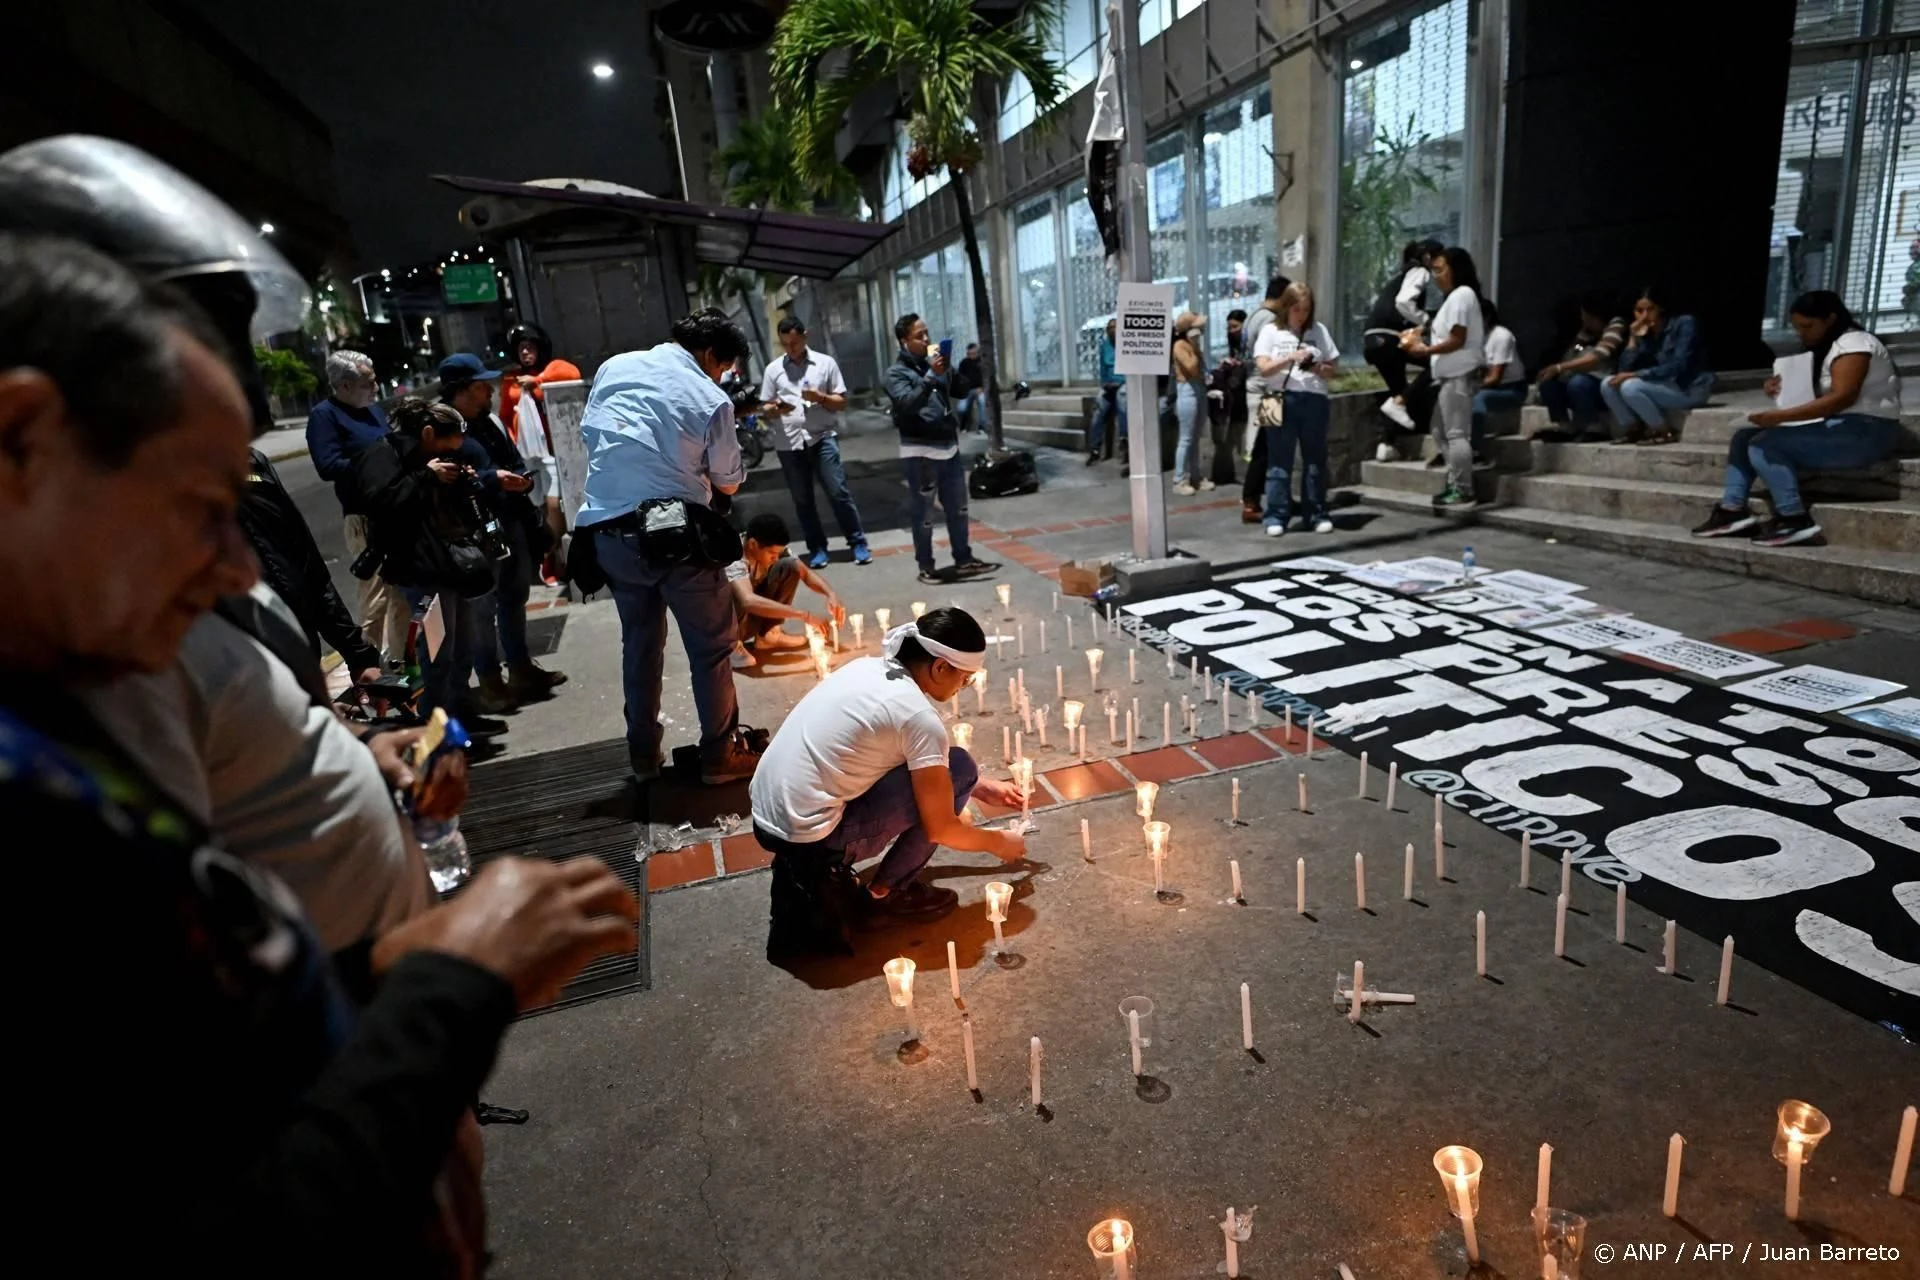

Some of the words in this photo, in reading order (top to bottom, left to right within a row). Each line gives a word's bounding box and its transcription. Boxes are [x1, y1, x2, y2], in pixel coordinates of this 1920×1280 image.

[1125, 317, 1164, 327] TODOS
[1137, 331, 1166, 339] PRESOS
[1231, 578, 1421, 642] LOS
[1291, 573, 1607, 672] LIBEREN
[1602, 678, 1693, 704] A
[1719, 703, 1920, 788] TO
